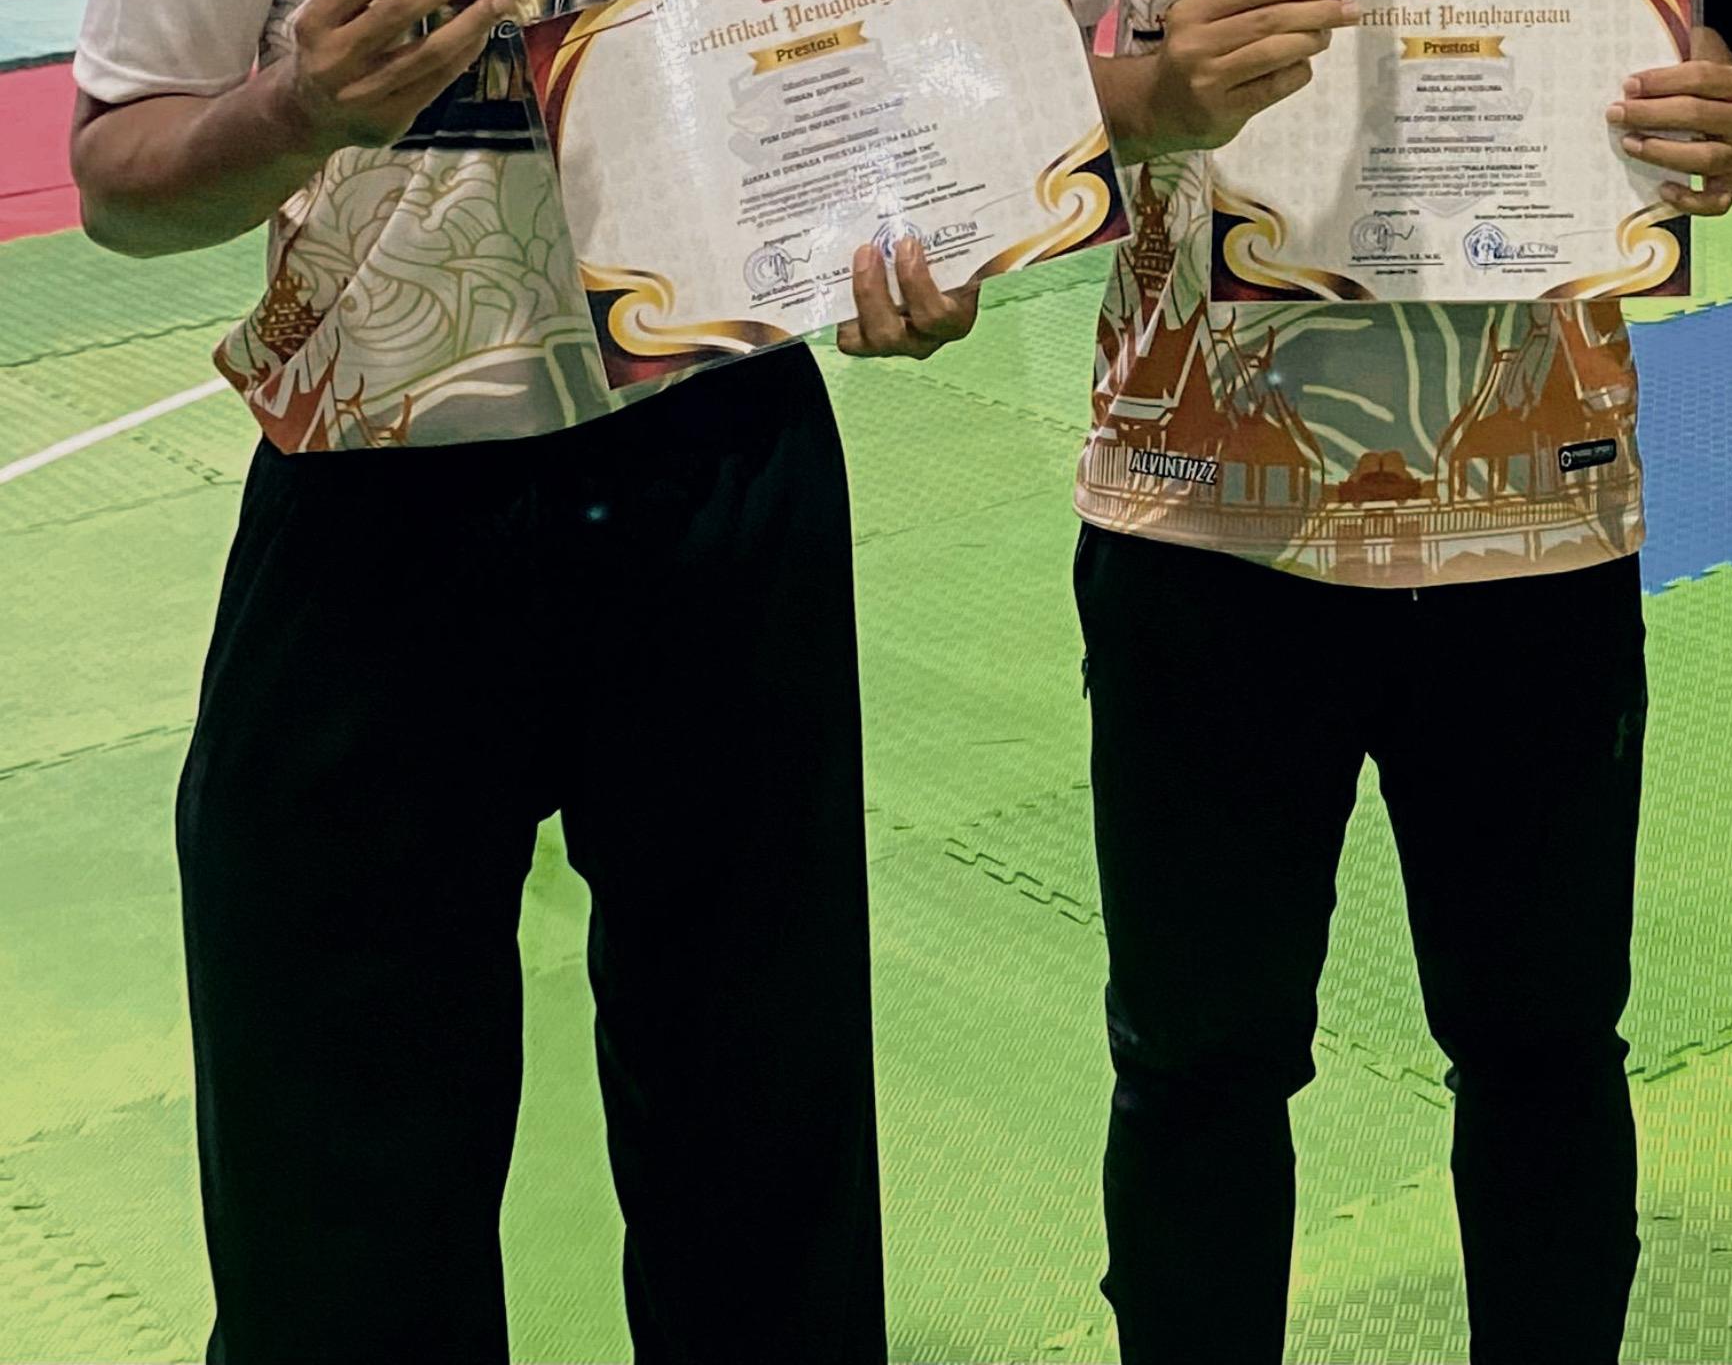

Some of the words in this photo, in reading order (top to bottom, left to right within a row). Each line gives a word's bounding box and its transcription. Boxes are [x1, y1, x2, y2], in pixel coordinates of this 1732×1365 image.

[1362, 6, 1431, 27] rtifikat
[1439, 4, 1571, 29] Penghargaan
[689, 14, 779, 56] ertifikat
[775, 34, 841, 63] Prestasi
[1423, 40, 1480, 54] Prestasi
[1130, 449, 1218, 483] ALVINTHZZ
